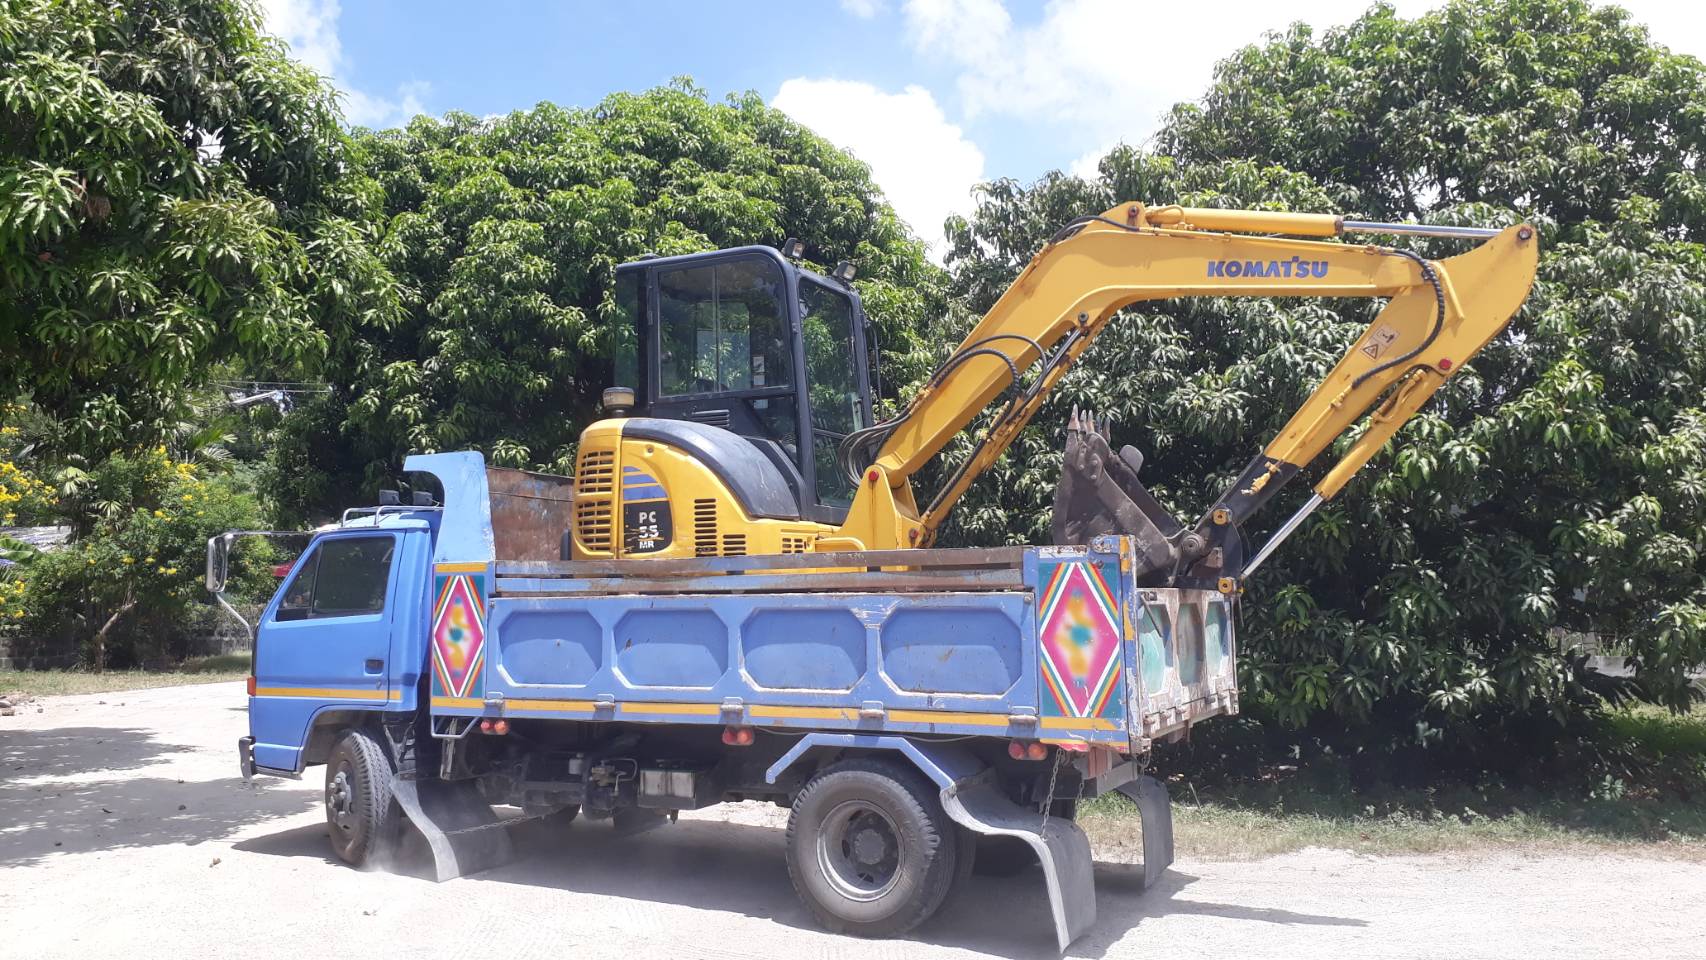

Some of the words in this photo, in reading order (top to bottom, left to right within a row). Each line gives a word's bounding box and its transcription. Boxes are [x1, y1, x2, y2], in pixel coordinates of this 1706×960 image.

[1207, 255, 1329, 278] KOMATSU
[639, 511, 657, 524] PC
[639, 540, 655, 549] MR
